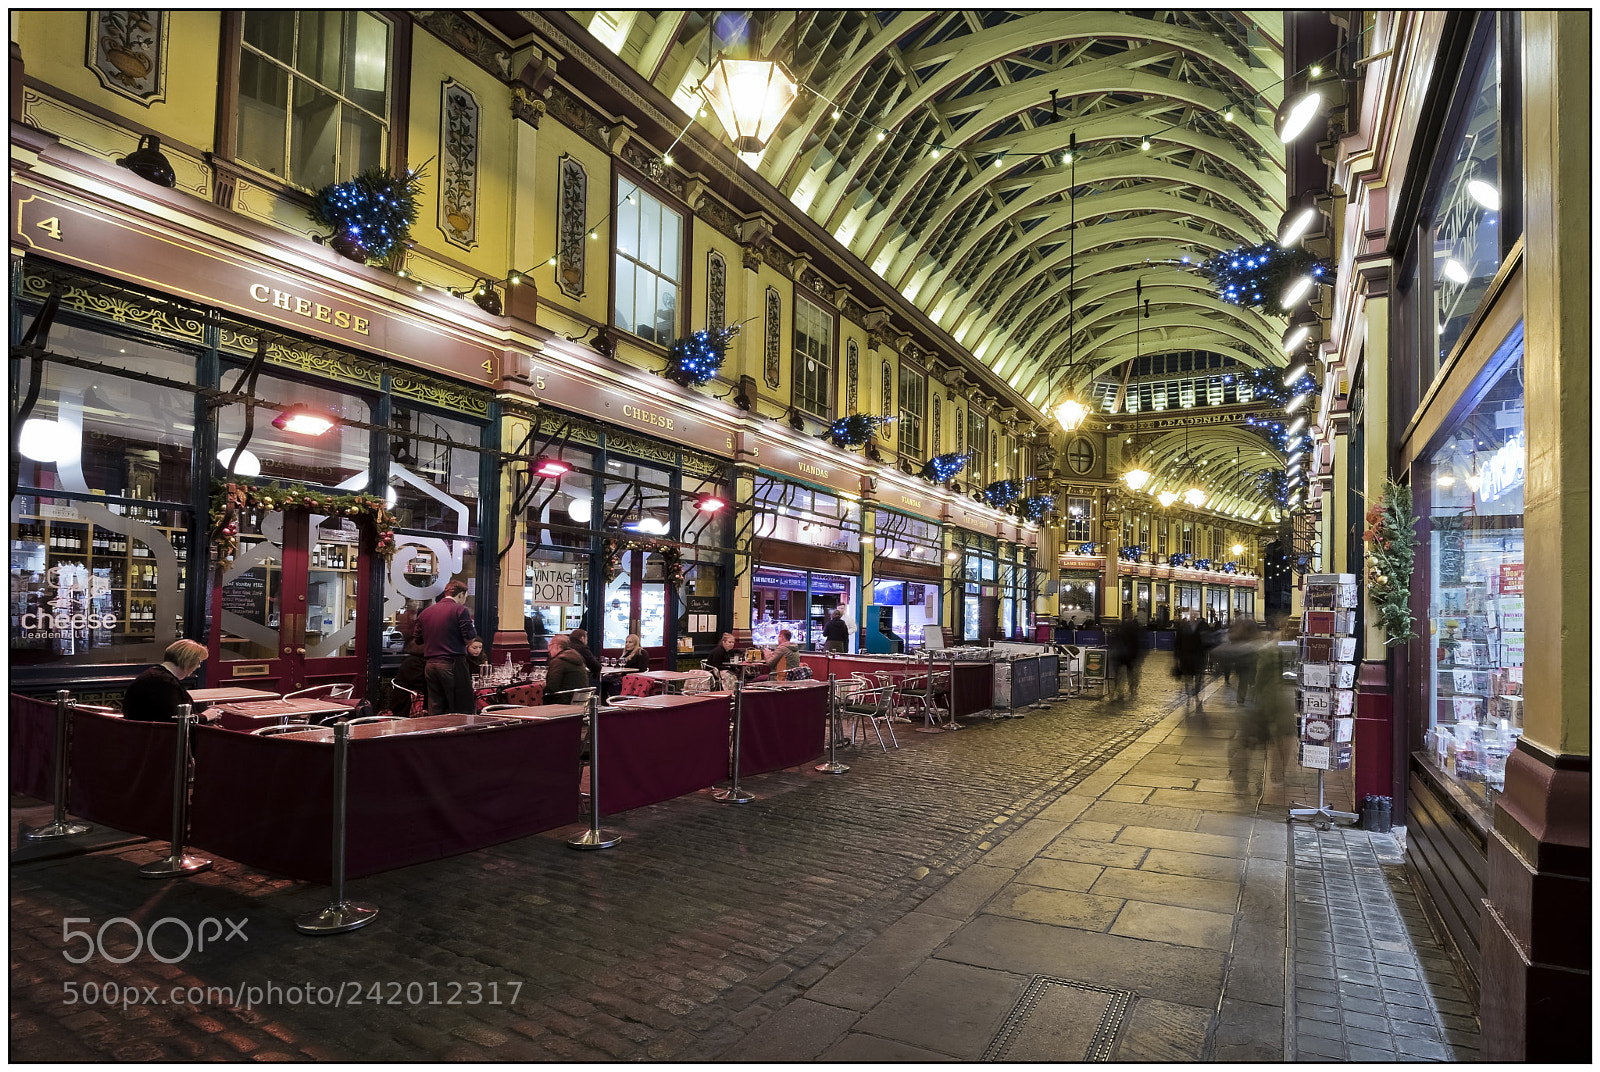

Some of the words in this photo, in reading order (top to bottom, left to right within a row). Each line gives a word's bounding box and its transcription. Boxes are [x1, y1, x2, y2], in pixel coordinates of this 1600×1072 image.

[36, 216, 62, 241] 4
[249, 283, 370, 336] CHEESE
[481, 360, 493, 374] 4
[536, 375, 547, 390] 5
[623, 404, 674, 431] CHEESE
[1158, 413, 1247, 428] LEADENHALL
[726, 438, 733, 449] 5
[798, 461, 829, 479] VIANDAS
[902, 495, 921, 508] VIANDAS
[533, 569, 574, 584] VINTAGE
[534, 584, 574, 602] PORT
[21, 607, 117, 630] cheese
[1307, 697, 1327, 708] Fab
